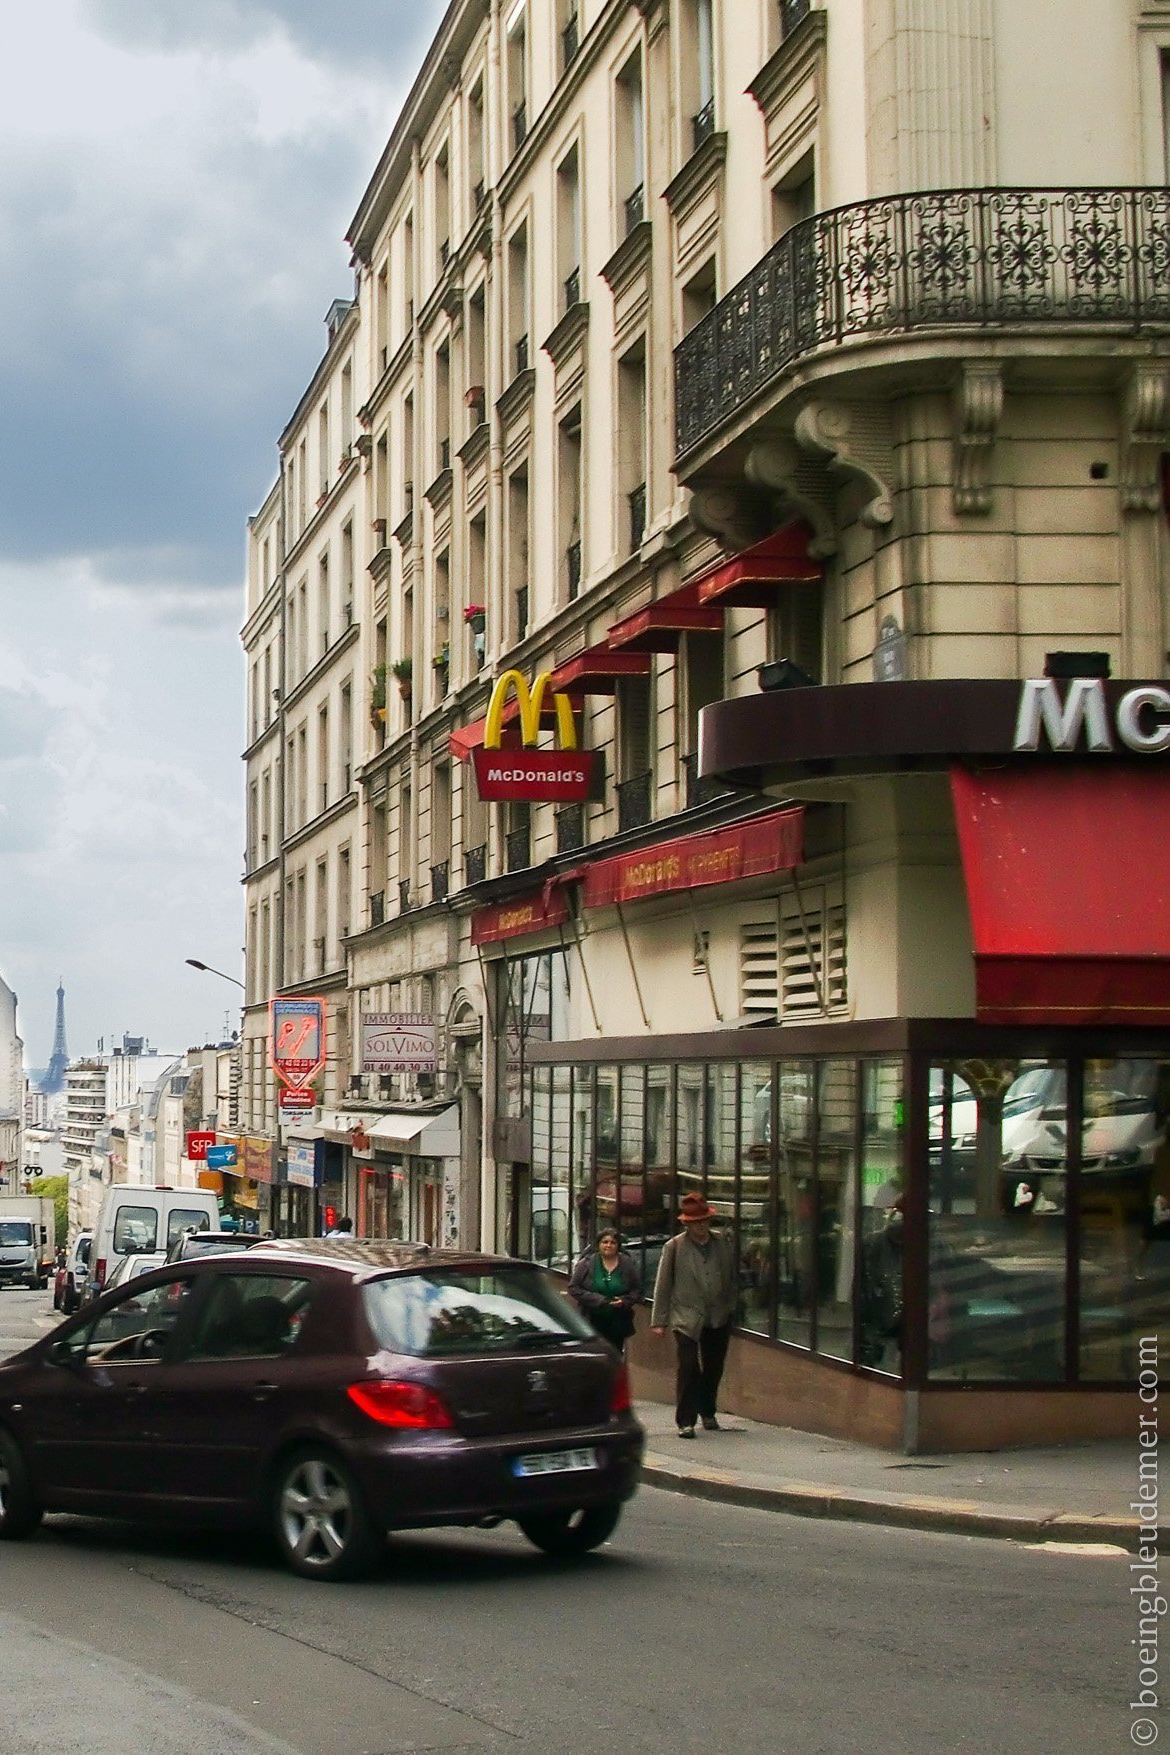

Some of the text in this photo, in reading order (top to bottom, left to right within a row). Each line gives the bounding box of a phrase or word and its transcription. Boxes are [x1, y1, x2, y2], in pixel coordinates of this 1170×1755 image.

[487, 769, 584, 782] McDonald's
[364, 1014, 433, 1025] IMMOBILIER
[366, 1037, 435, 1055] SOLVIMO
[364, 1062, 435, 1072] 01 40 40 30 31
